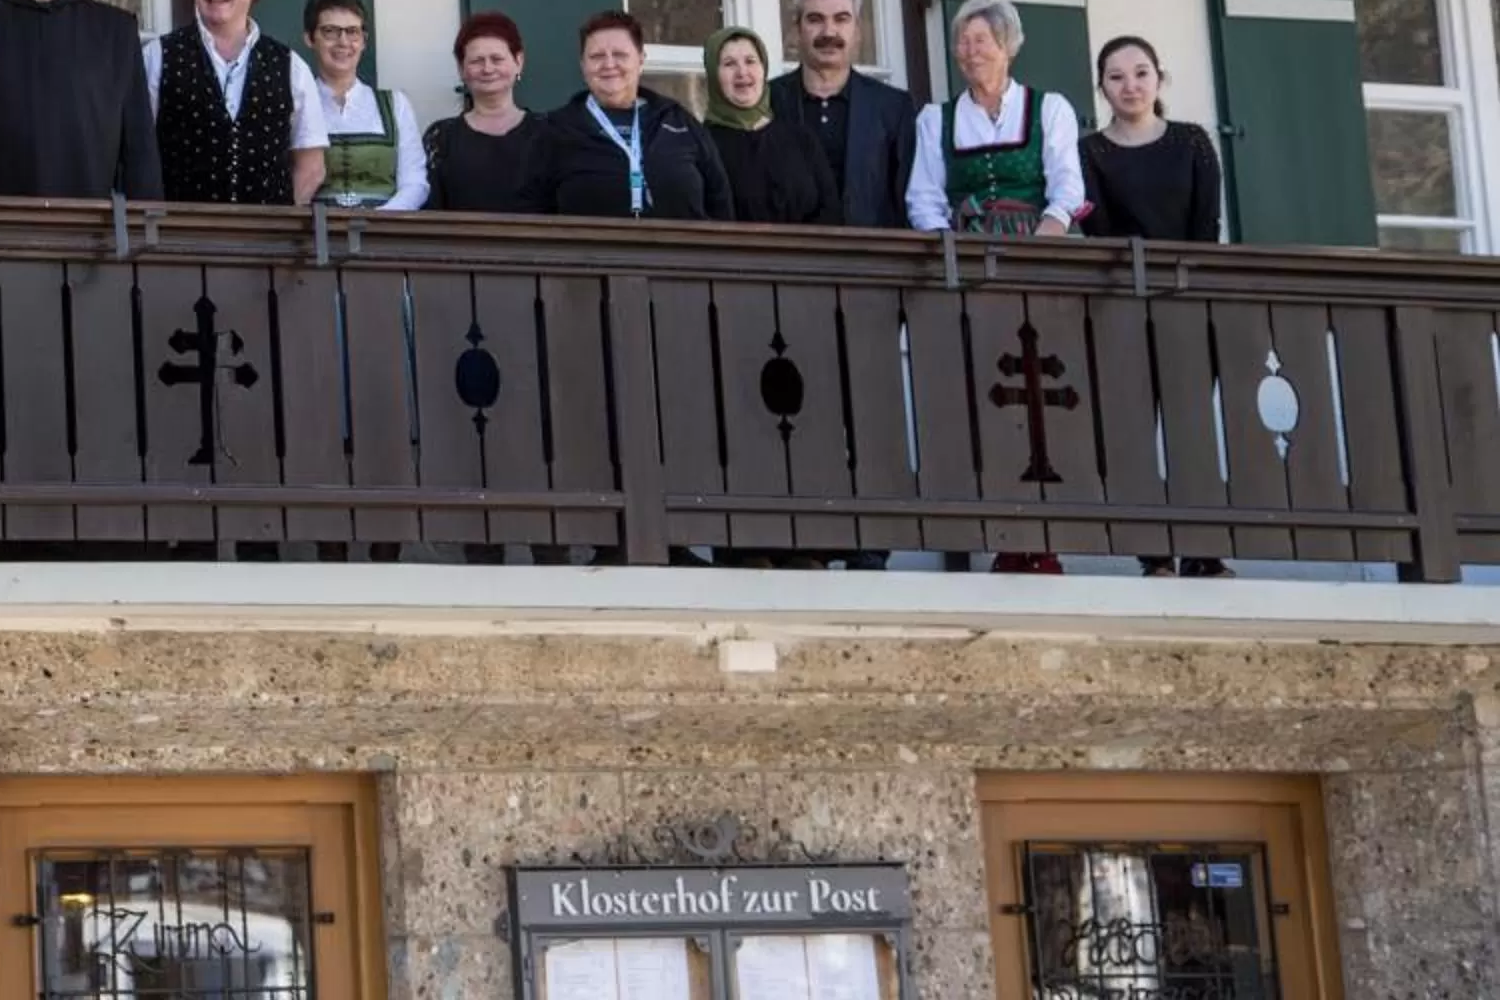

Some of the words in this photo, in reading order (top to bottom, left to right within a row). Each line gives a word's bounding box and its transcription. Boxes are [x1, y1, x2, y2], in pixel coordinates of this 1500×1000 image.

[552, 875, 738, 916] Klosterhof
[743, 889, 799, 913] zur
[808, 878, 881, 913] Post
